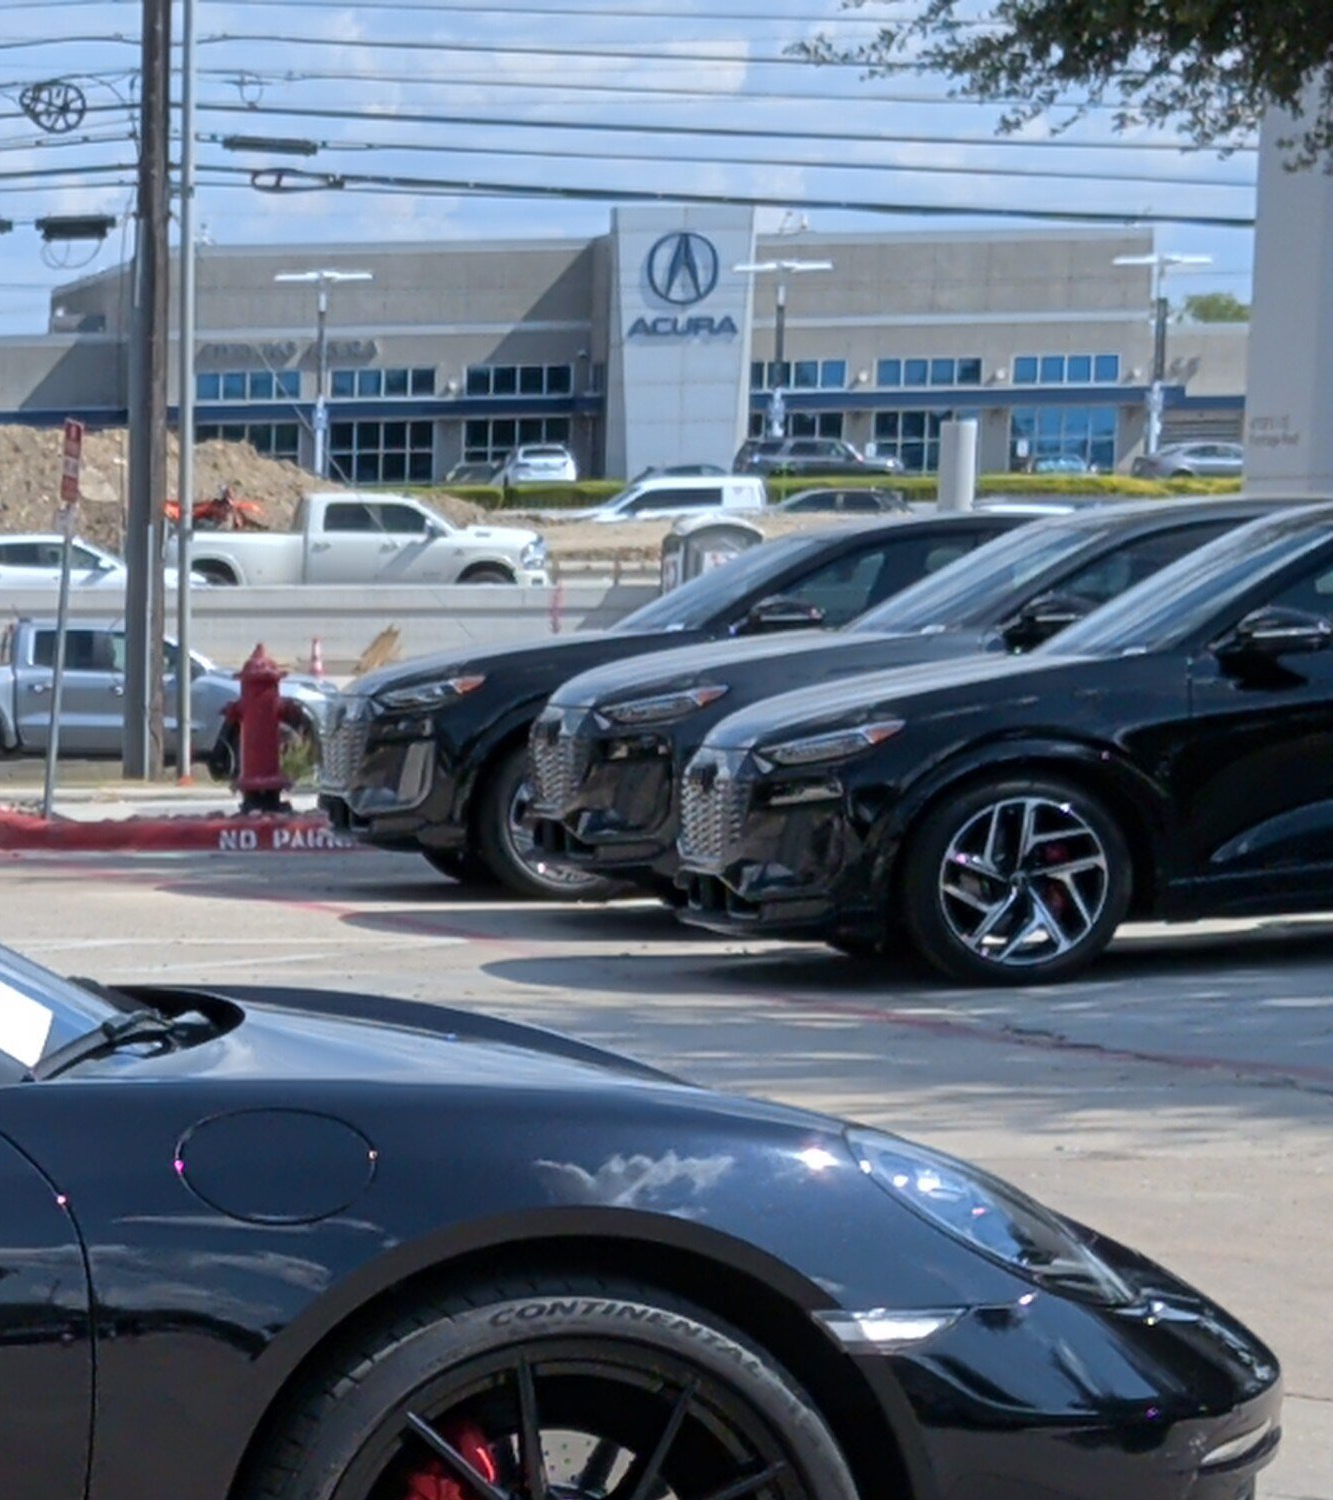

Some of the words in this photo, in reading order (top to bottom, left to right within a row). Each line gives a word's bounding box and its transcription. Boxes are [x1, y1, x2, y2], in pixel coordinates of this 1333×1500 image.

[627, 316, 738, 337] ACURA
[219, 829, 257, 850] NO
[489, 1300, 764, 1379] CONTINENTAL
